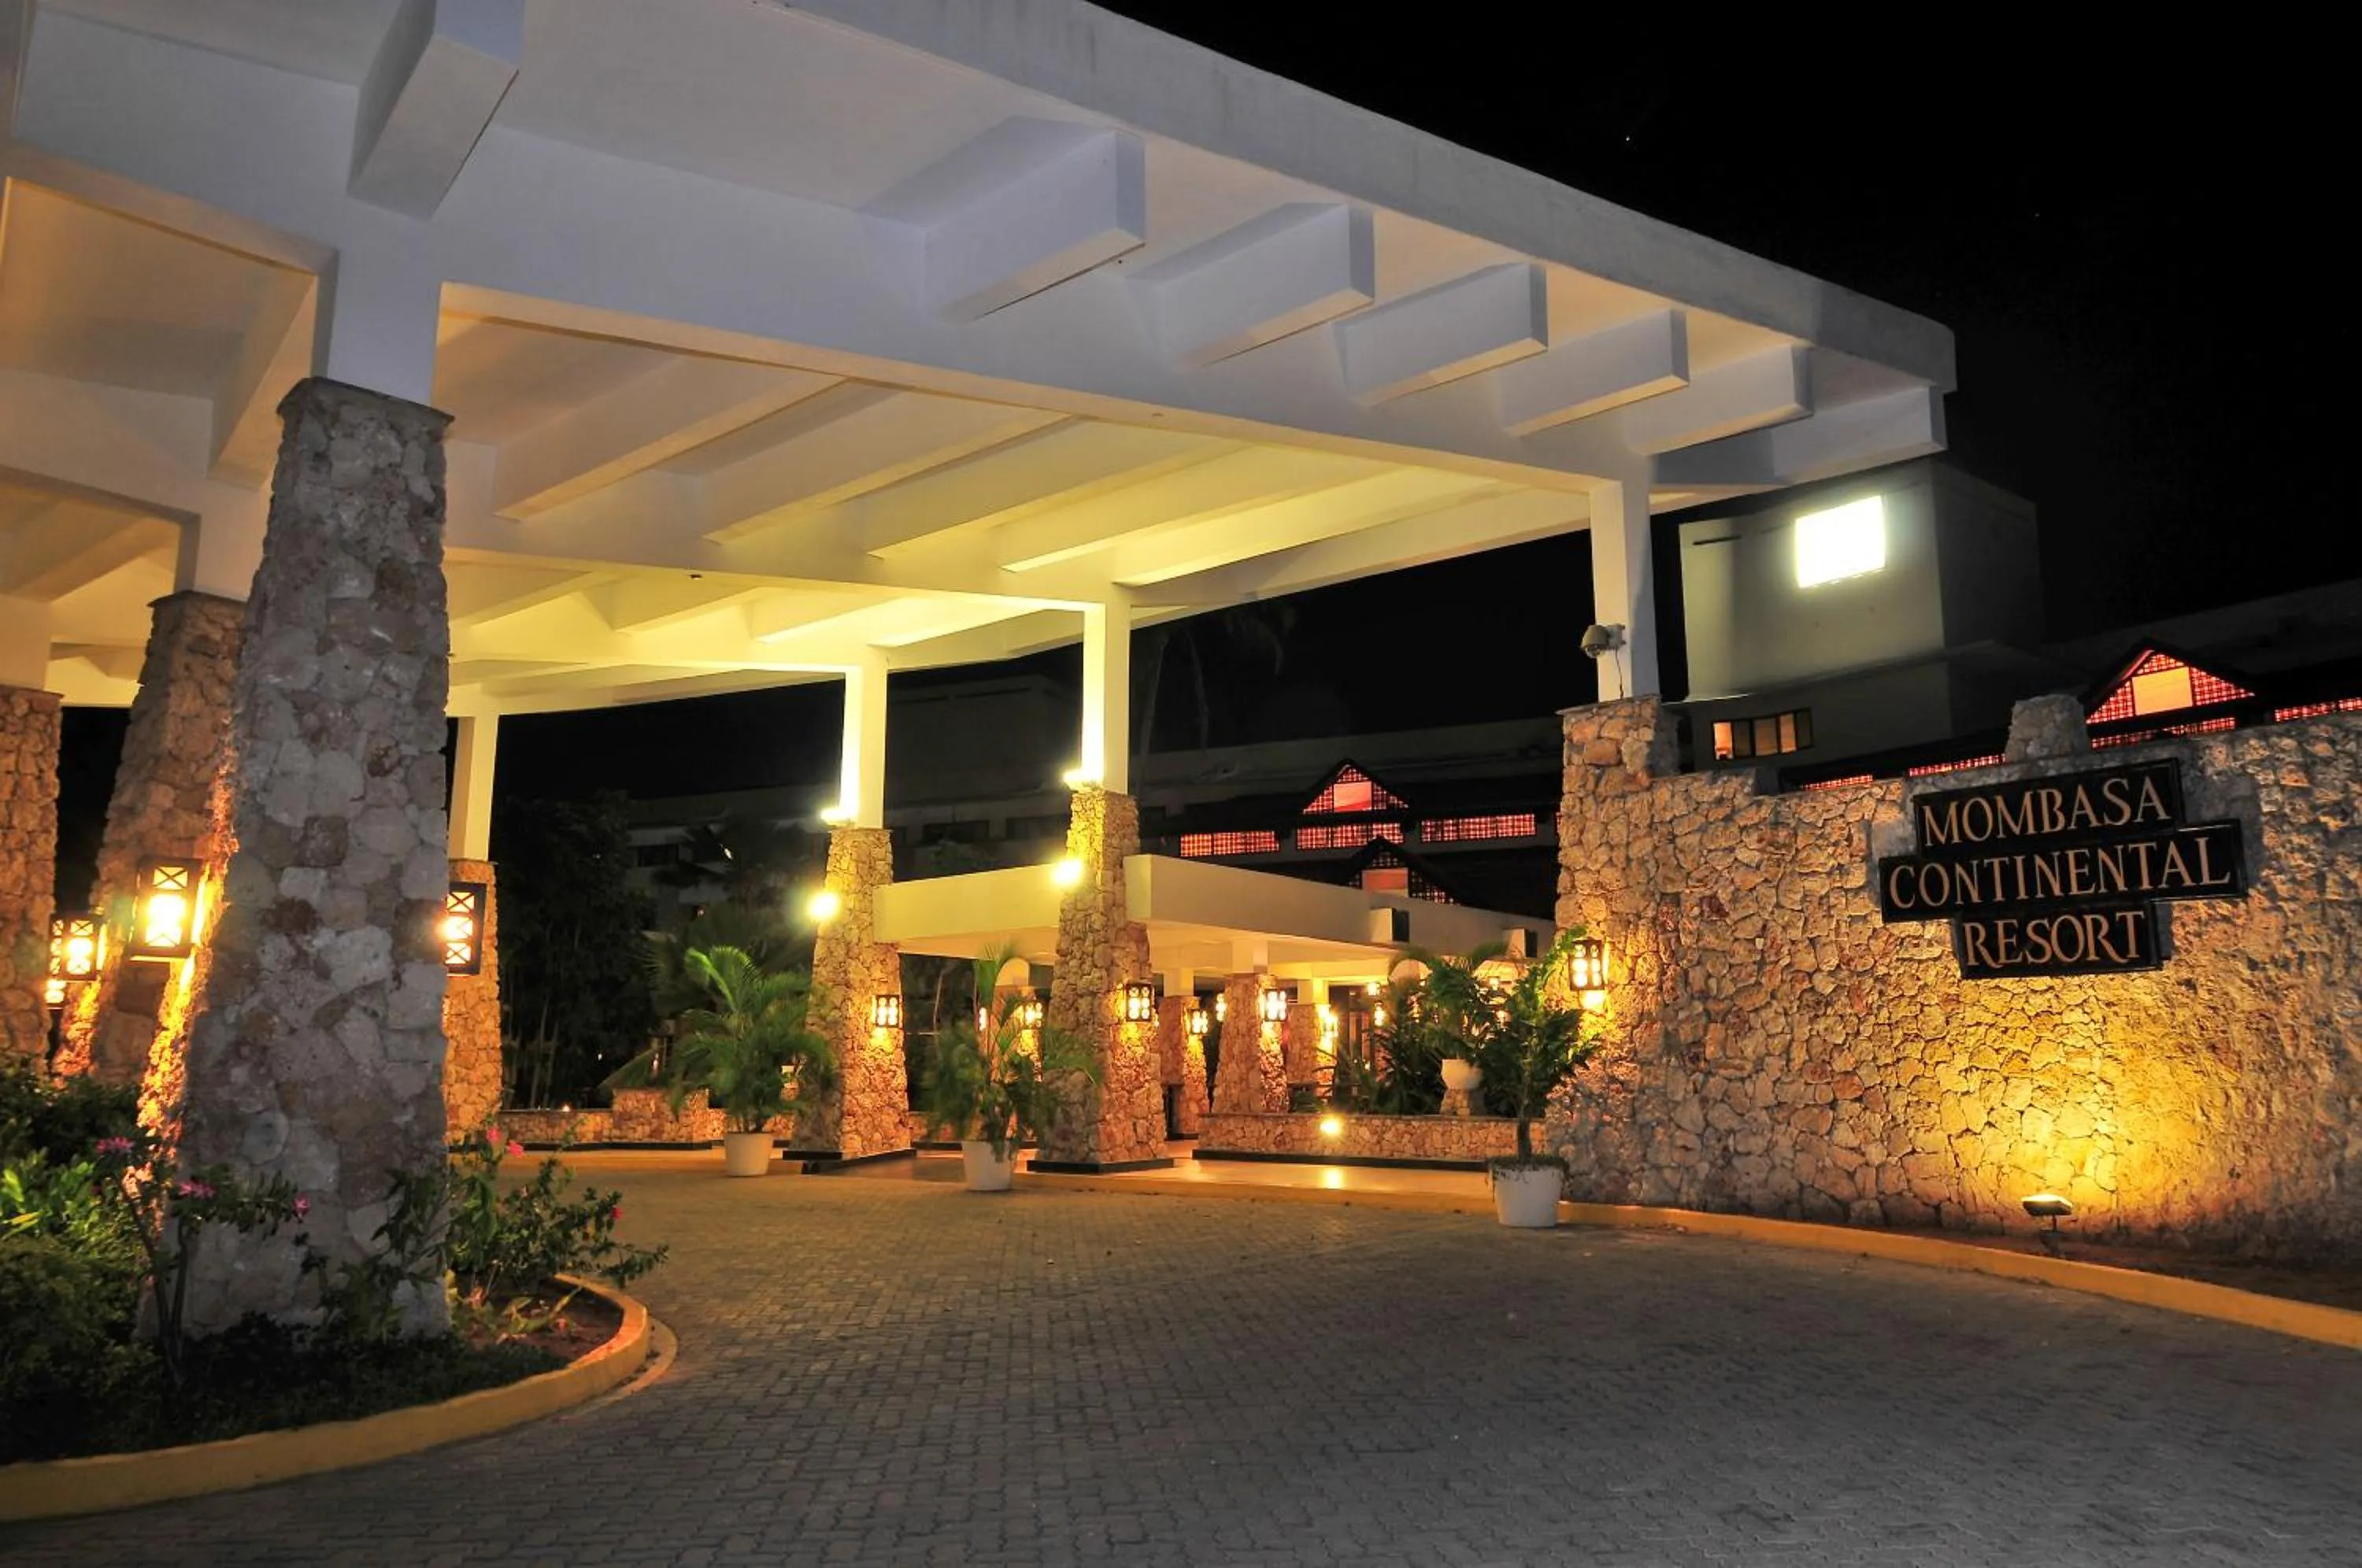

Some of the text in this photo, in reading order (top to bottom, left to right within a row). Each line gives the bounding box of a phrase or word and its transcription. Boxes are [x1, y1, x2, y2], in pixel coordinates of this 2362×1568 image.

[1921, 775, 2171, 847] MOMBASA
[1890, 837, 2231, 909] CONTINENTAL
[1963, 910, 2145, 969] RESORT
